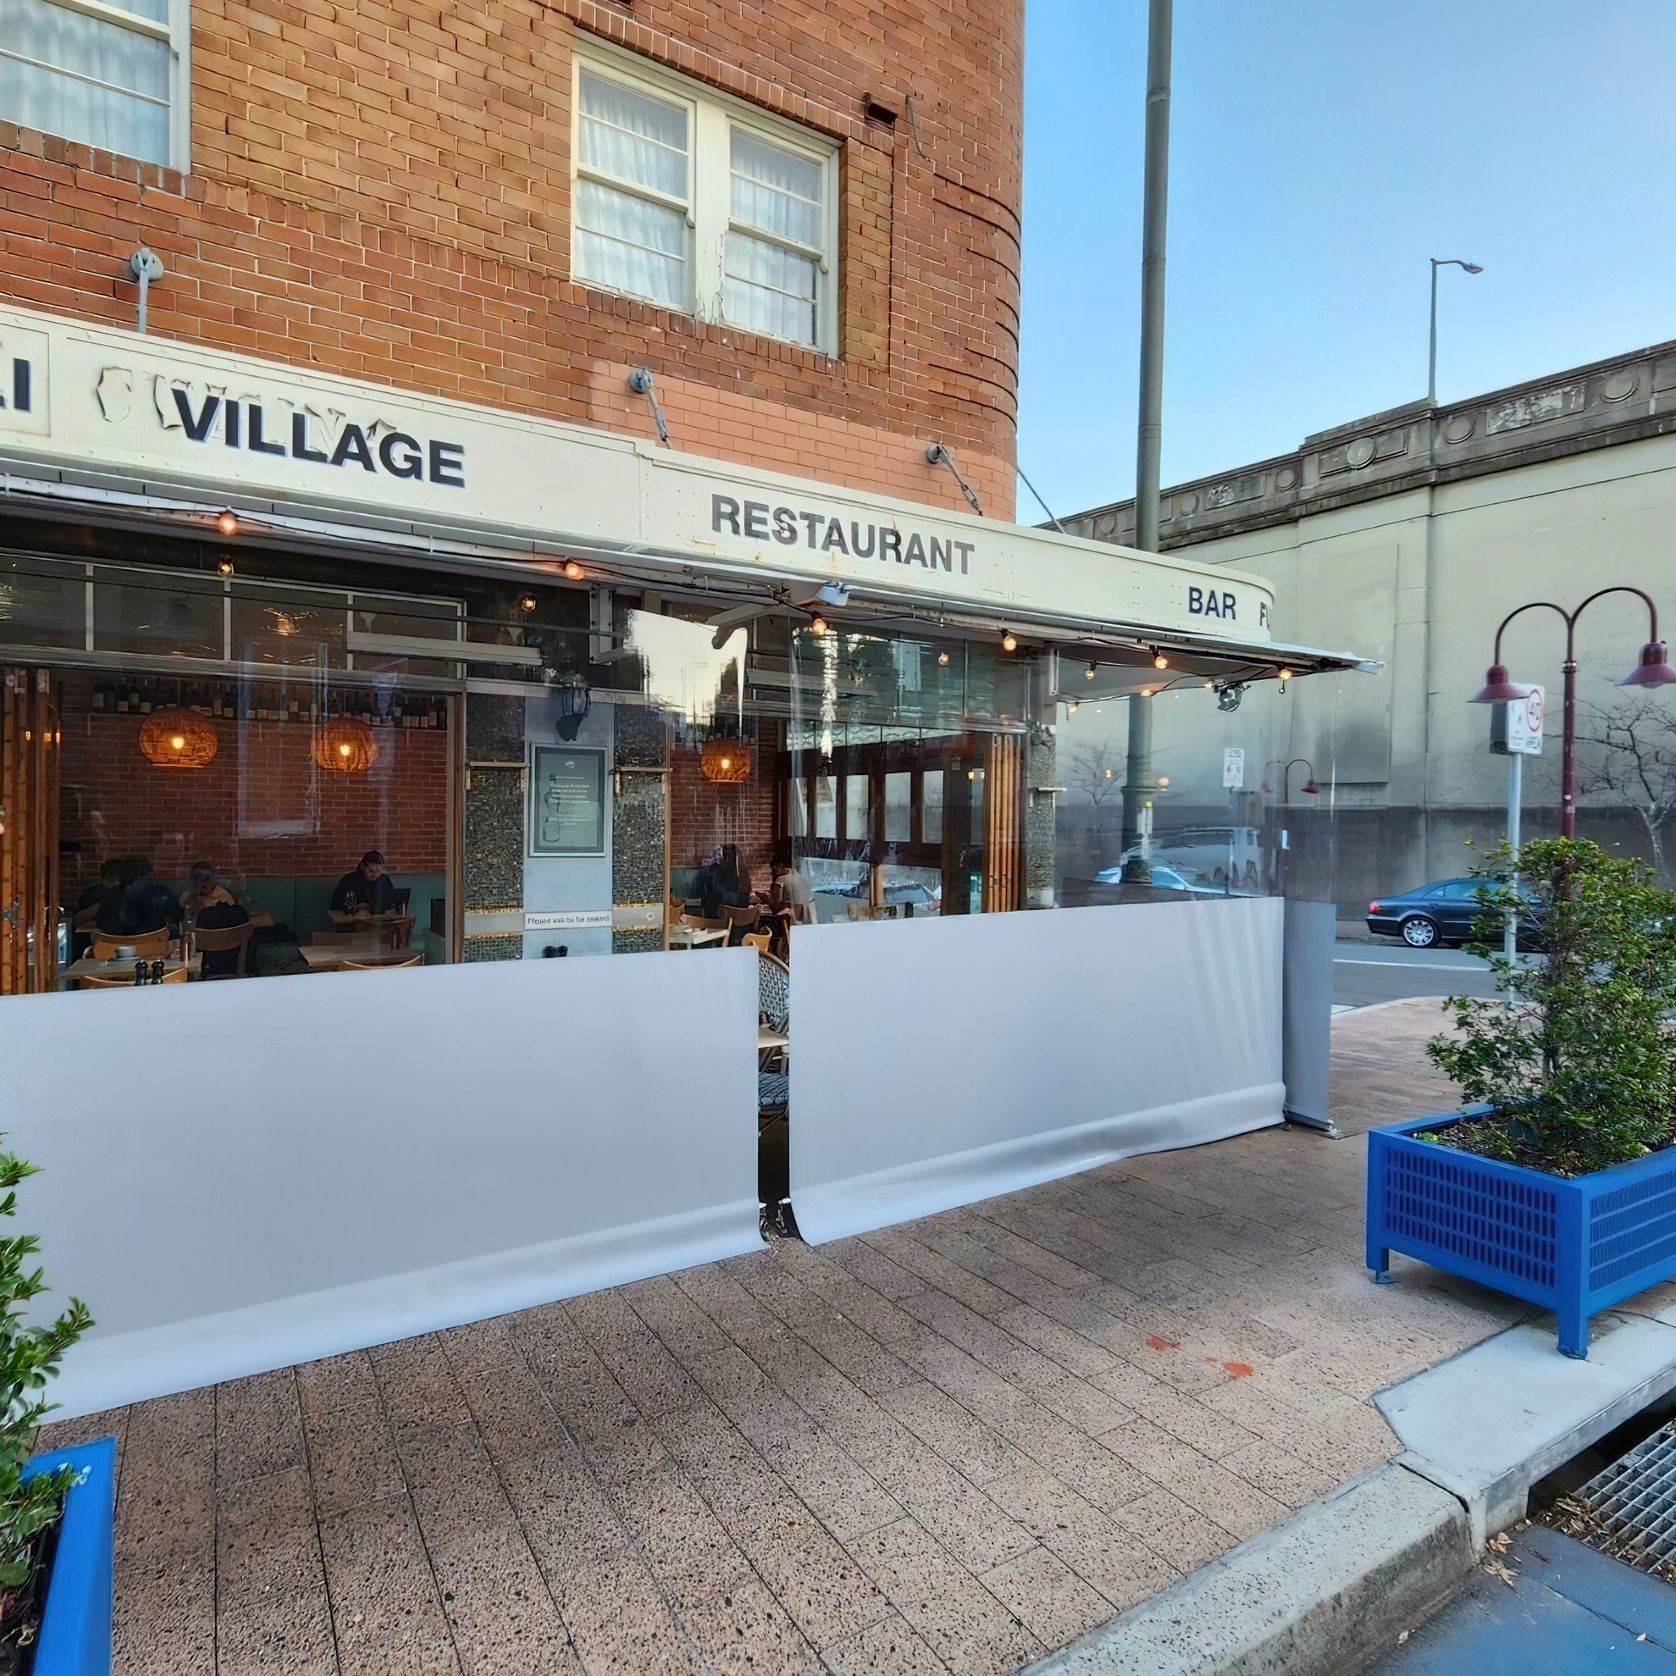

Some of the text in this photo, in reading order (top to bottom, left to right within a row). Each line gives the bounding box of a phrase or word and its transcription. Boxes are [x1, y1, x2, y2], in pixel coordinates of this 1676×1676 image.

[170, 387, 465, 488] VILLAGE
[711, 493, 975, 575] RESTAURANT
[1189, 586, 1236, 620] BAR
